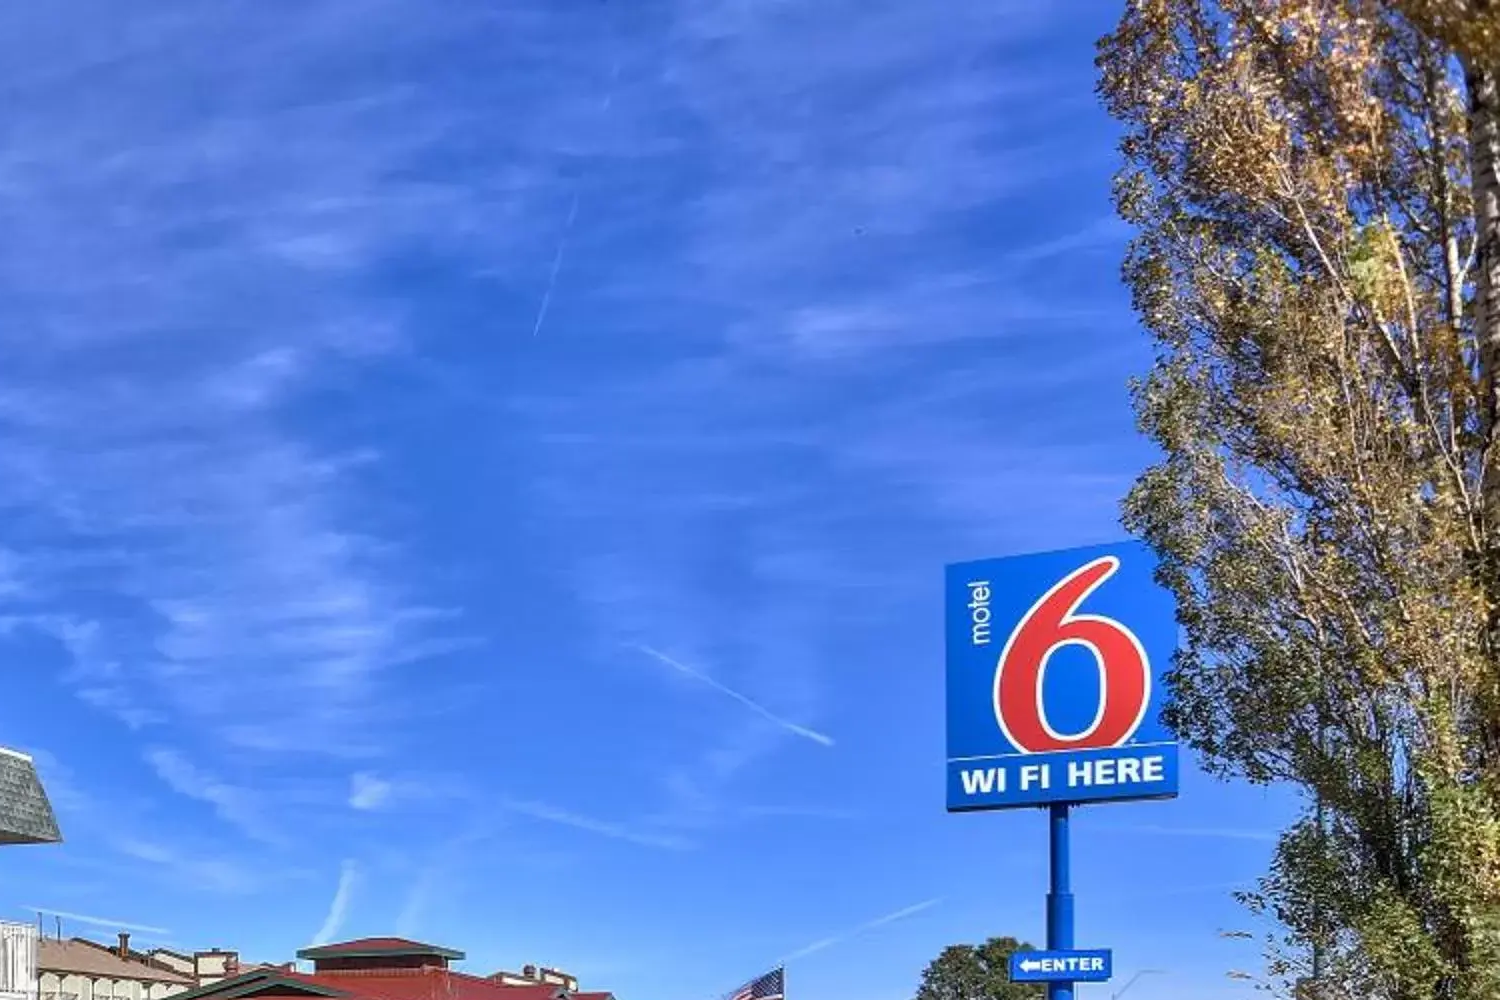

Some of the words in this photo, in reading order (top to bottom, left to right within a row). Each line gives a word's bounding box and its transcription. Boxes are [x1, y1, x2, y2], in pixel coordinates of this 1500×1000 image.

[967, 581, 991, 645] motel
[993, 555, 1152, 753] 6
[961, 767, 1006, 795] WI
[1019, 764, 1049, 791] FI
[1067, 756, 1164, 787] HERE
[1041, 957, 1104, 973] ENTER
